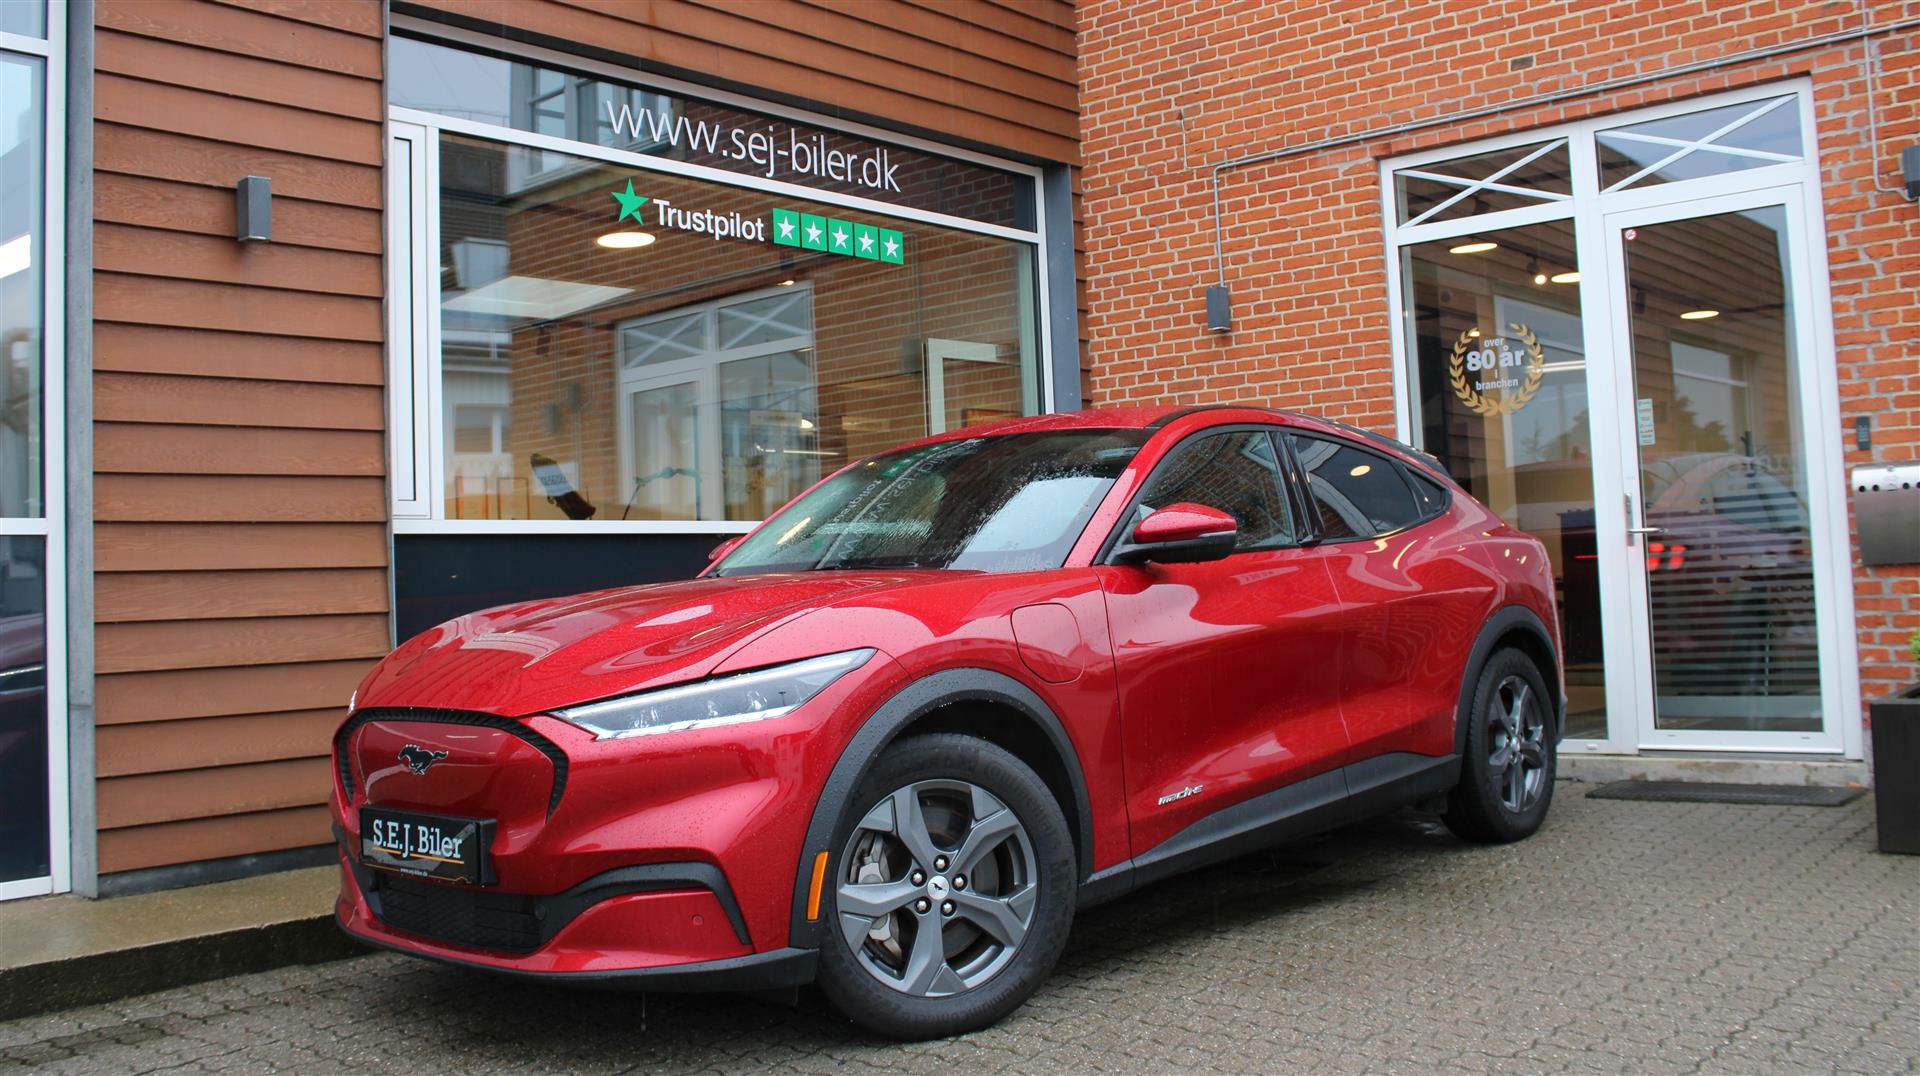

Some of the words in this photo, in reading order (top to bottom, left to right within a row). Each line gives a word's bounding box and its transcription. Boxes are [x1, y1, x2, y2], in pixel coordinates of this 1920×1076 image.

[606, 100, 901, 193] www.sej-biler.dk
[653, 198, 765, 242] Trustpilot
[1466, 349, 1496, 371] 80
[1499, 344, 1525, 367] år
[1484, 337, 1505, 348] over
[1475, 377, 1519, 391] branchen
[373, 819, 414, 858] S.E.J.
[418, 825, 463, 859] Biler
